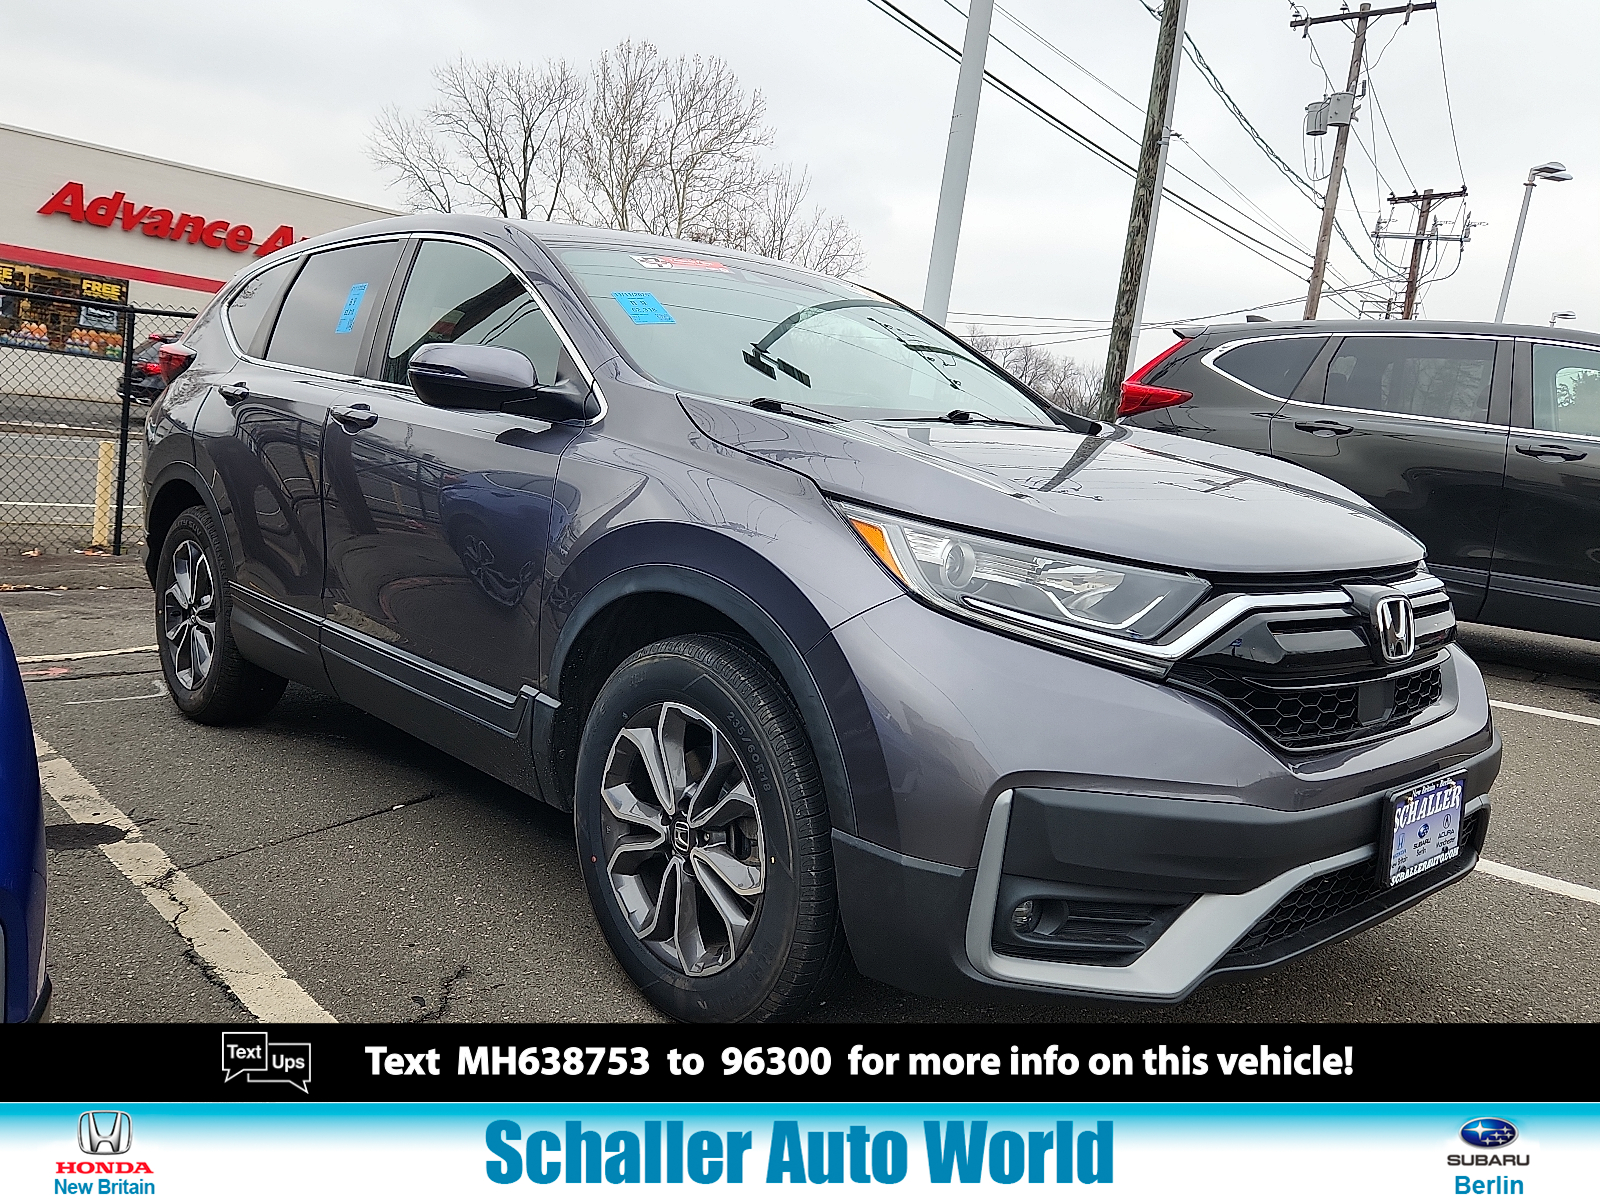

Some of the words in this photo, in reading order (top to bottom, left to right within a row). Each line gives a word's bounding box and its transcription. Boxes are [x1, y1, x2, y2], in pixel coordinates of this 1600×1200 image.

[36, 181, 253, 253] Advance
[253, 224, 311, 257] A
[82, 280, 121, 296] FREE
[726, 711, 771, 792] 235/60R18
[1394, 785, 1462, 834] SCHALLER
[1438, 828, 1455, 840] ACURA
